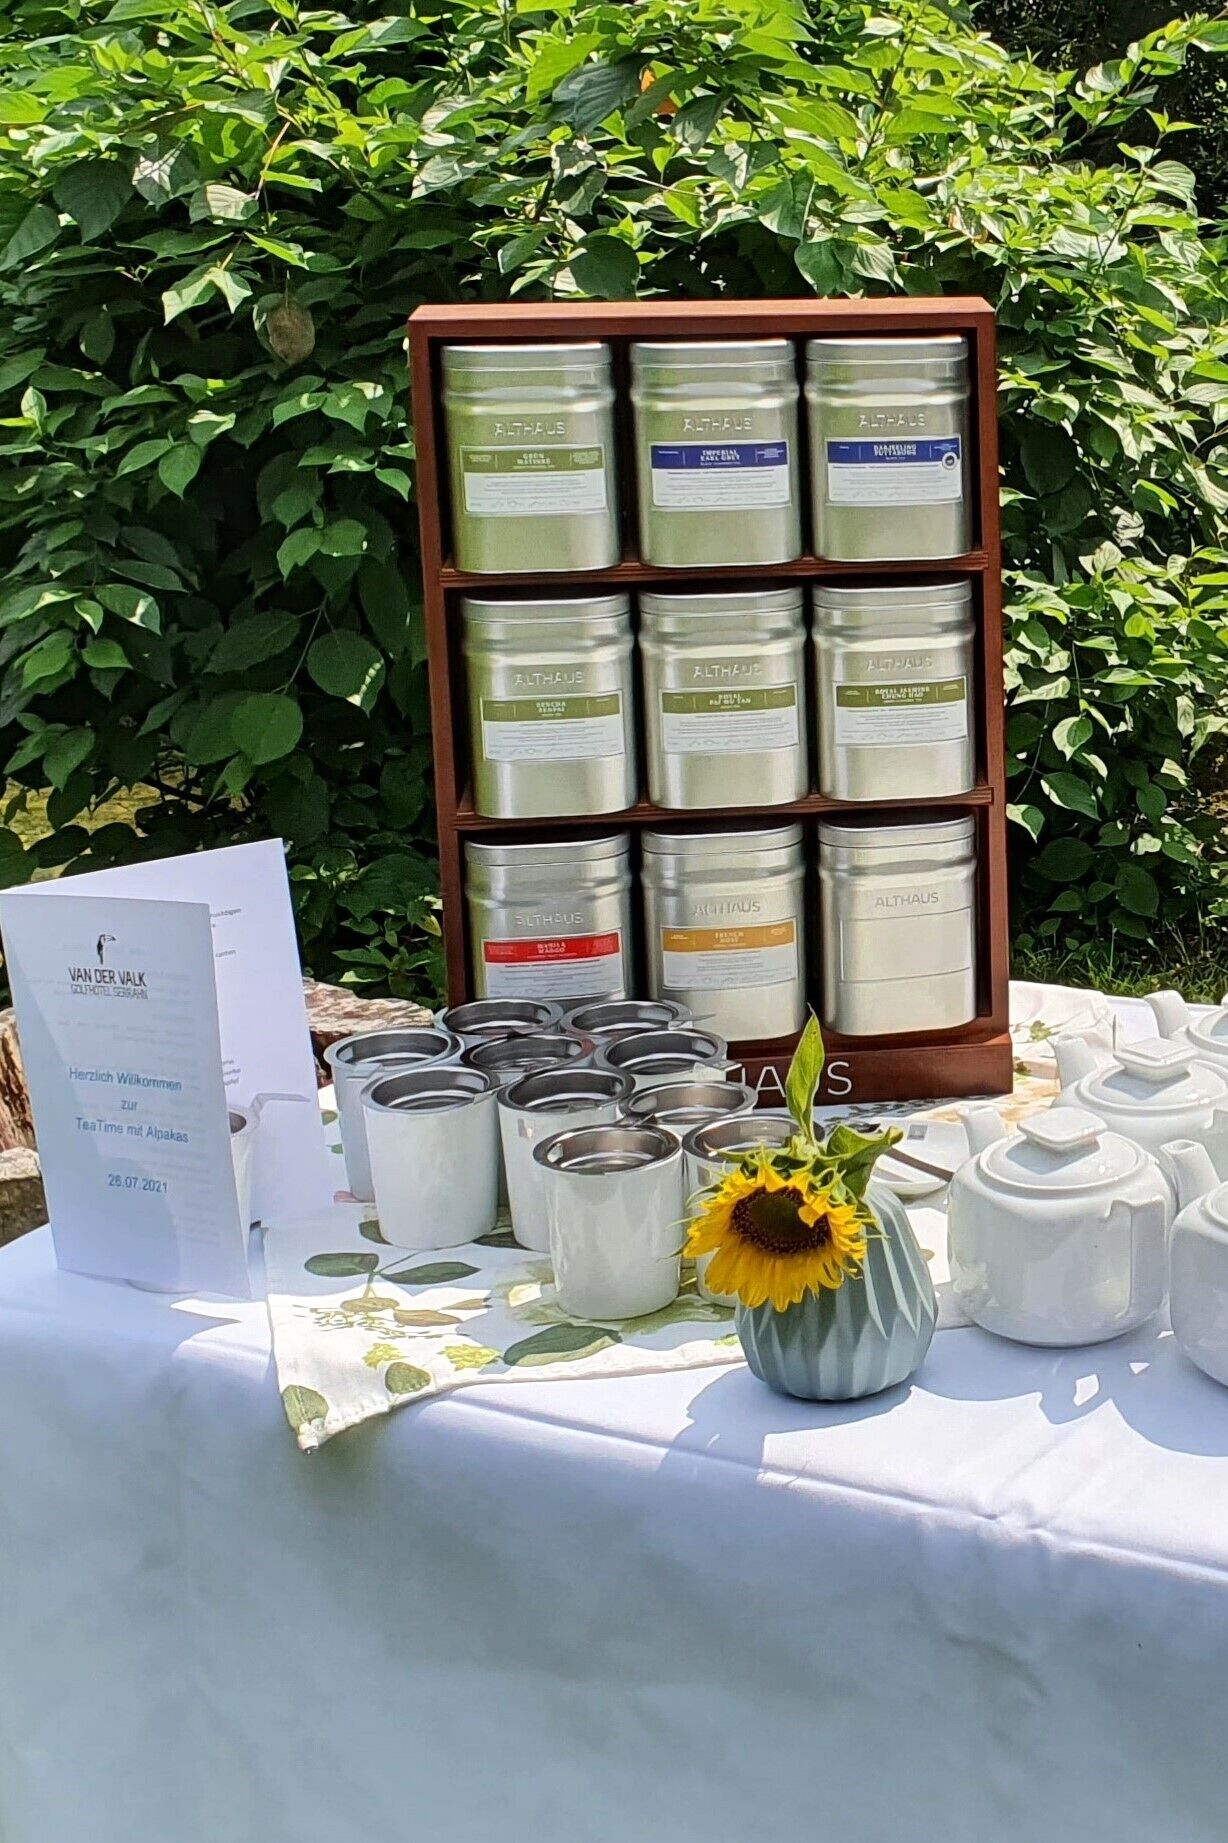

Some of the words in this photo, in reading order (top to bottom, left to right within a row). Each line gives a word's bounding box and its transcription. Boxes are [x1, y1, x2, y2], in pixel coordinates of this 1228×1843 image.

[683, 417, 752, 432] ALTHAUS
[859, 413, 926, 428] ALTHAUS
[495, 421, 567, 437] ALTHAUS
[693, 664, 763, 678] ALTHAUS
[867, 657, 933, 672] ALTHAUS
[515, 671, 585, 686] ALTHAUS
[873, 892, 939, 908] ALTHAUS
[694, 900, 761, 916] ALTHAUS
[515, 912, 584, 927] ALTHAUS
[68, 966, 93, 983] VAN
[94, 968, 117, 985] DER
[118, 970, 148, 988] VALK
[69, 1067, 114, 1084] Herzlich
[116, 1070, 182, 1091] Willkommen
[121, 1099, 139, 1111] zur
[76, 1117, 124, 1135] TeaTime
[127, 1123, 144, 1138] mit
[146, 1125, 190, 1144] Alpakas
